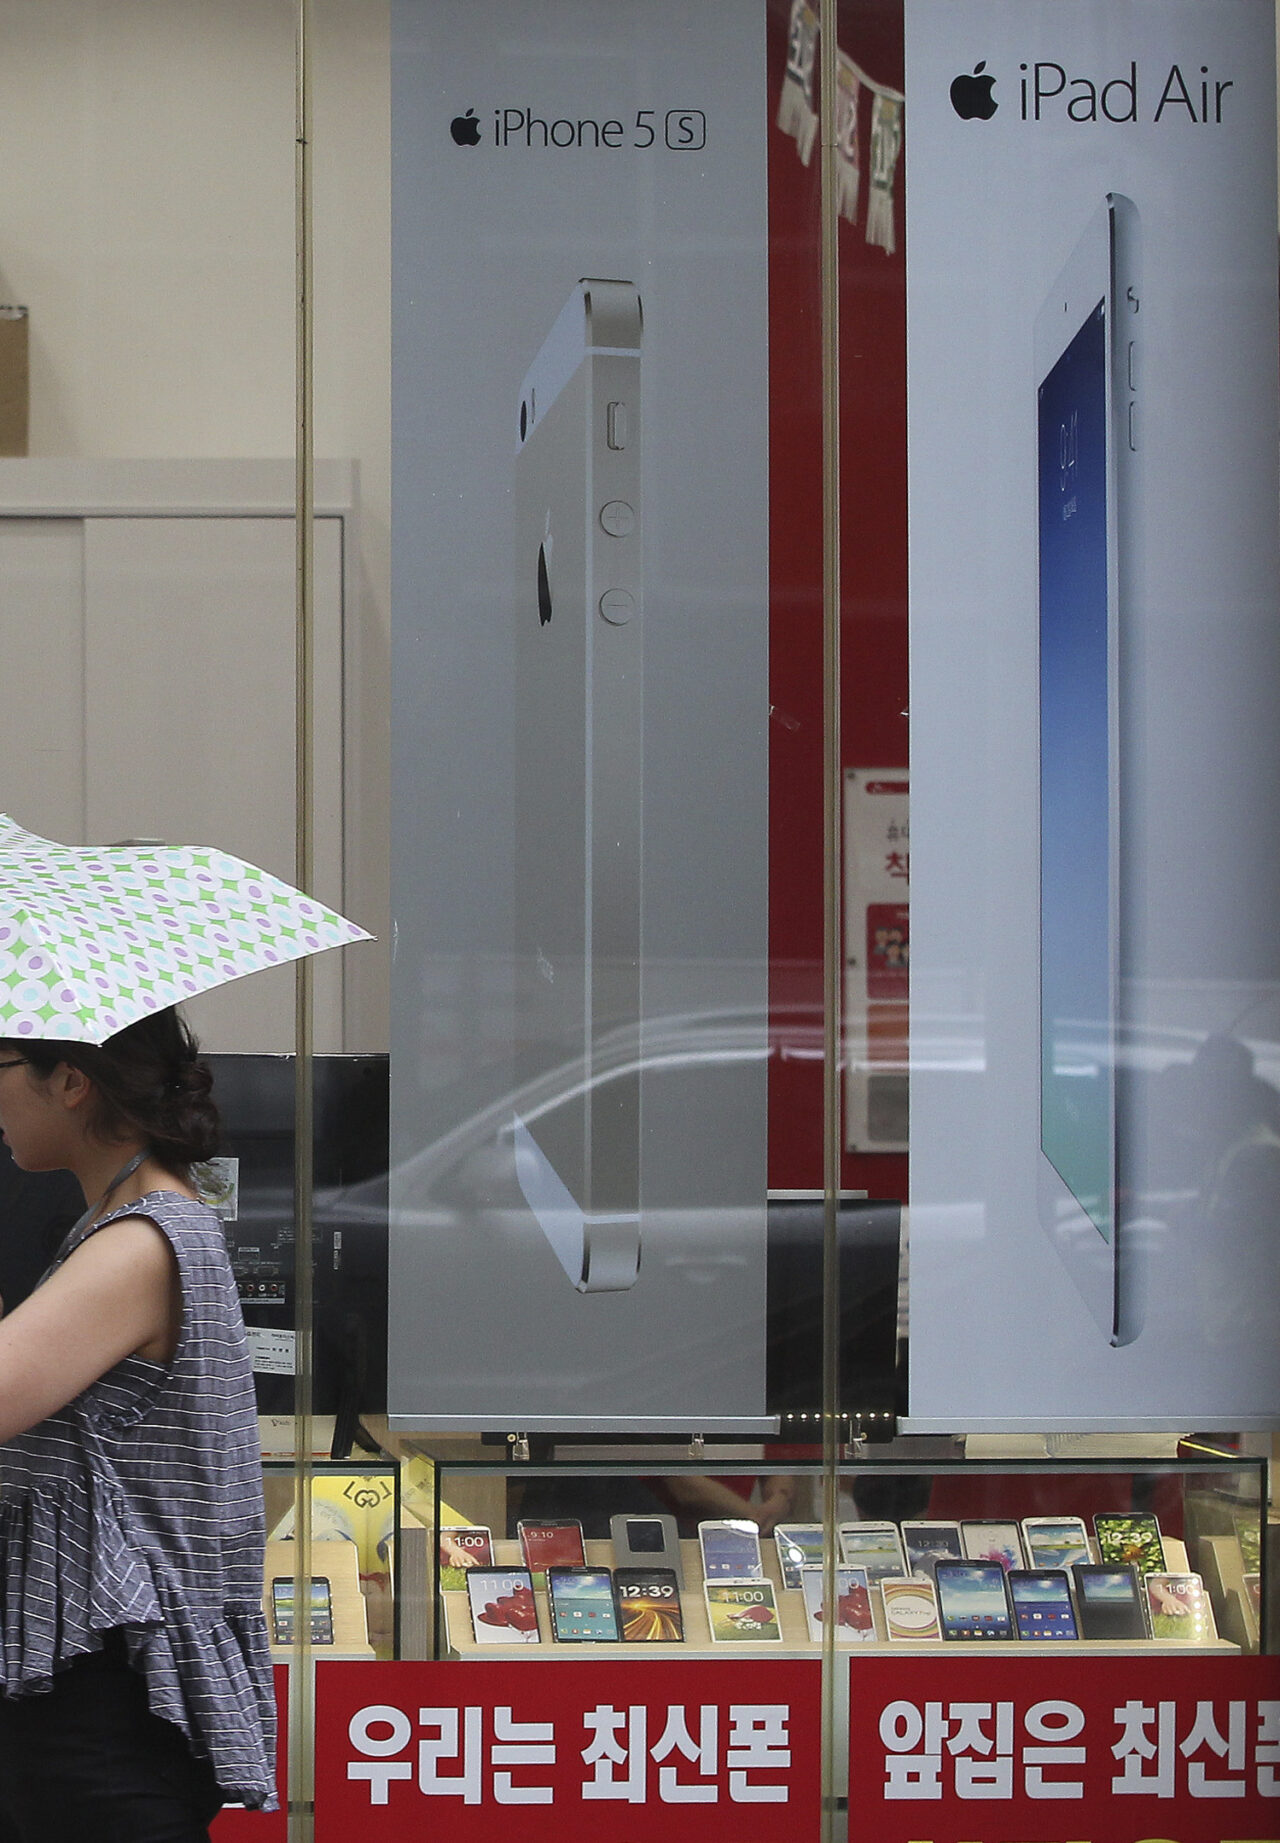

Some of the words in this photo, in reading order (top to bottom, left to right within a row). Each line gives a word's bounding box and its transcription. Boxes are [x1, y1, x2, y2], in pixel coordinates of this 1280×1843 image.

[1019, 61, 1138, 123] iPad
[1154, 64, 1234, 124] Air
[494, 107, 624, 149] iPhone
[446, 1536, 484, 1547] 11:00
[620, 1584, 674, 1598] 12:39
[722, 1590, 764, 1603] 11:00
[348, 1704, 555, 1805] 우리는
[581, 1704, 790, 1804] 최신폰
[880, 1700, 1085, 1800] 앞집은
